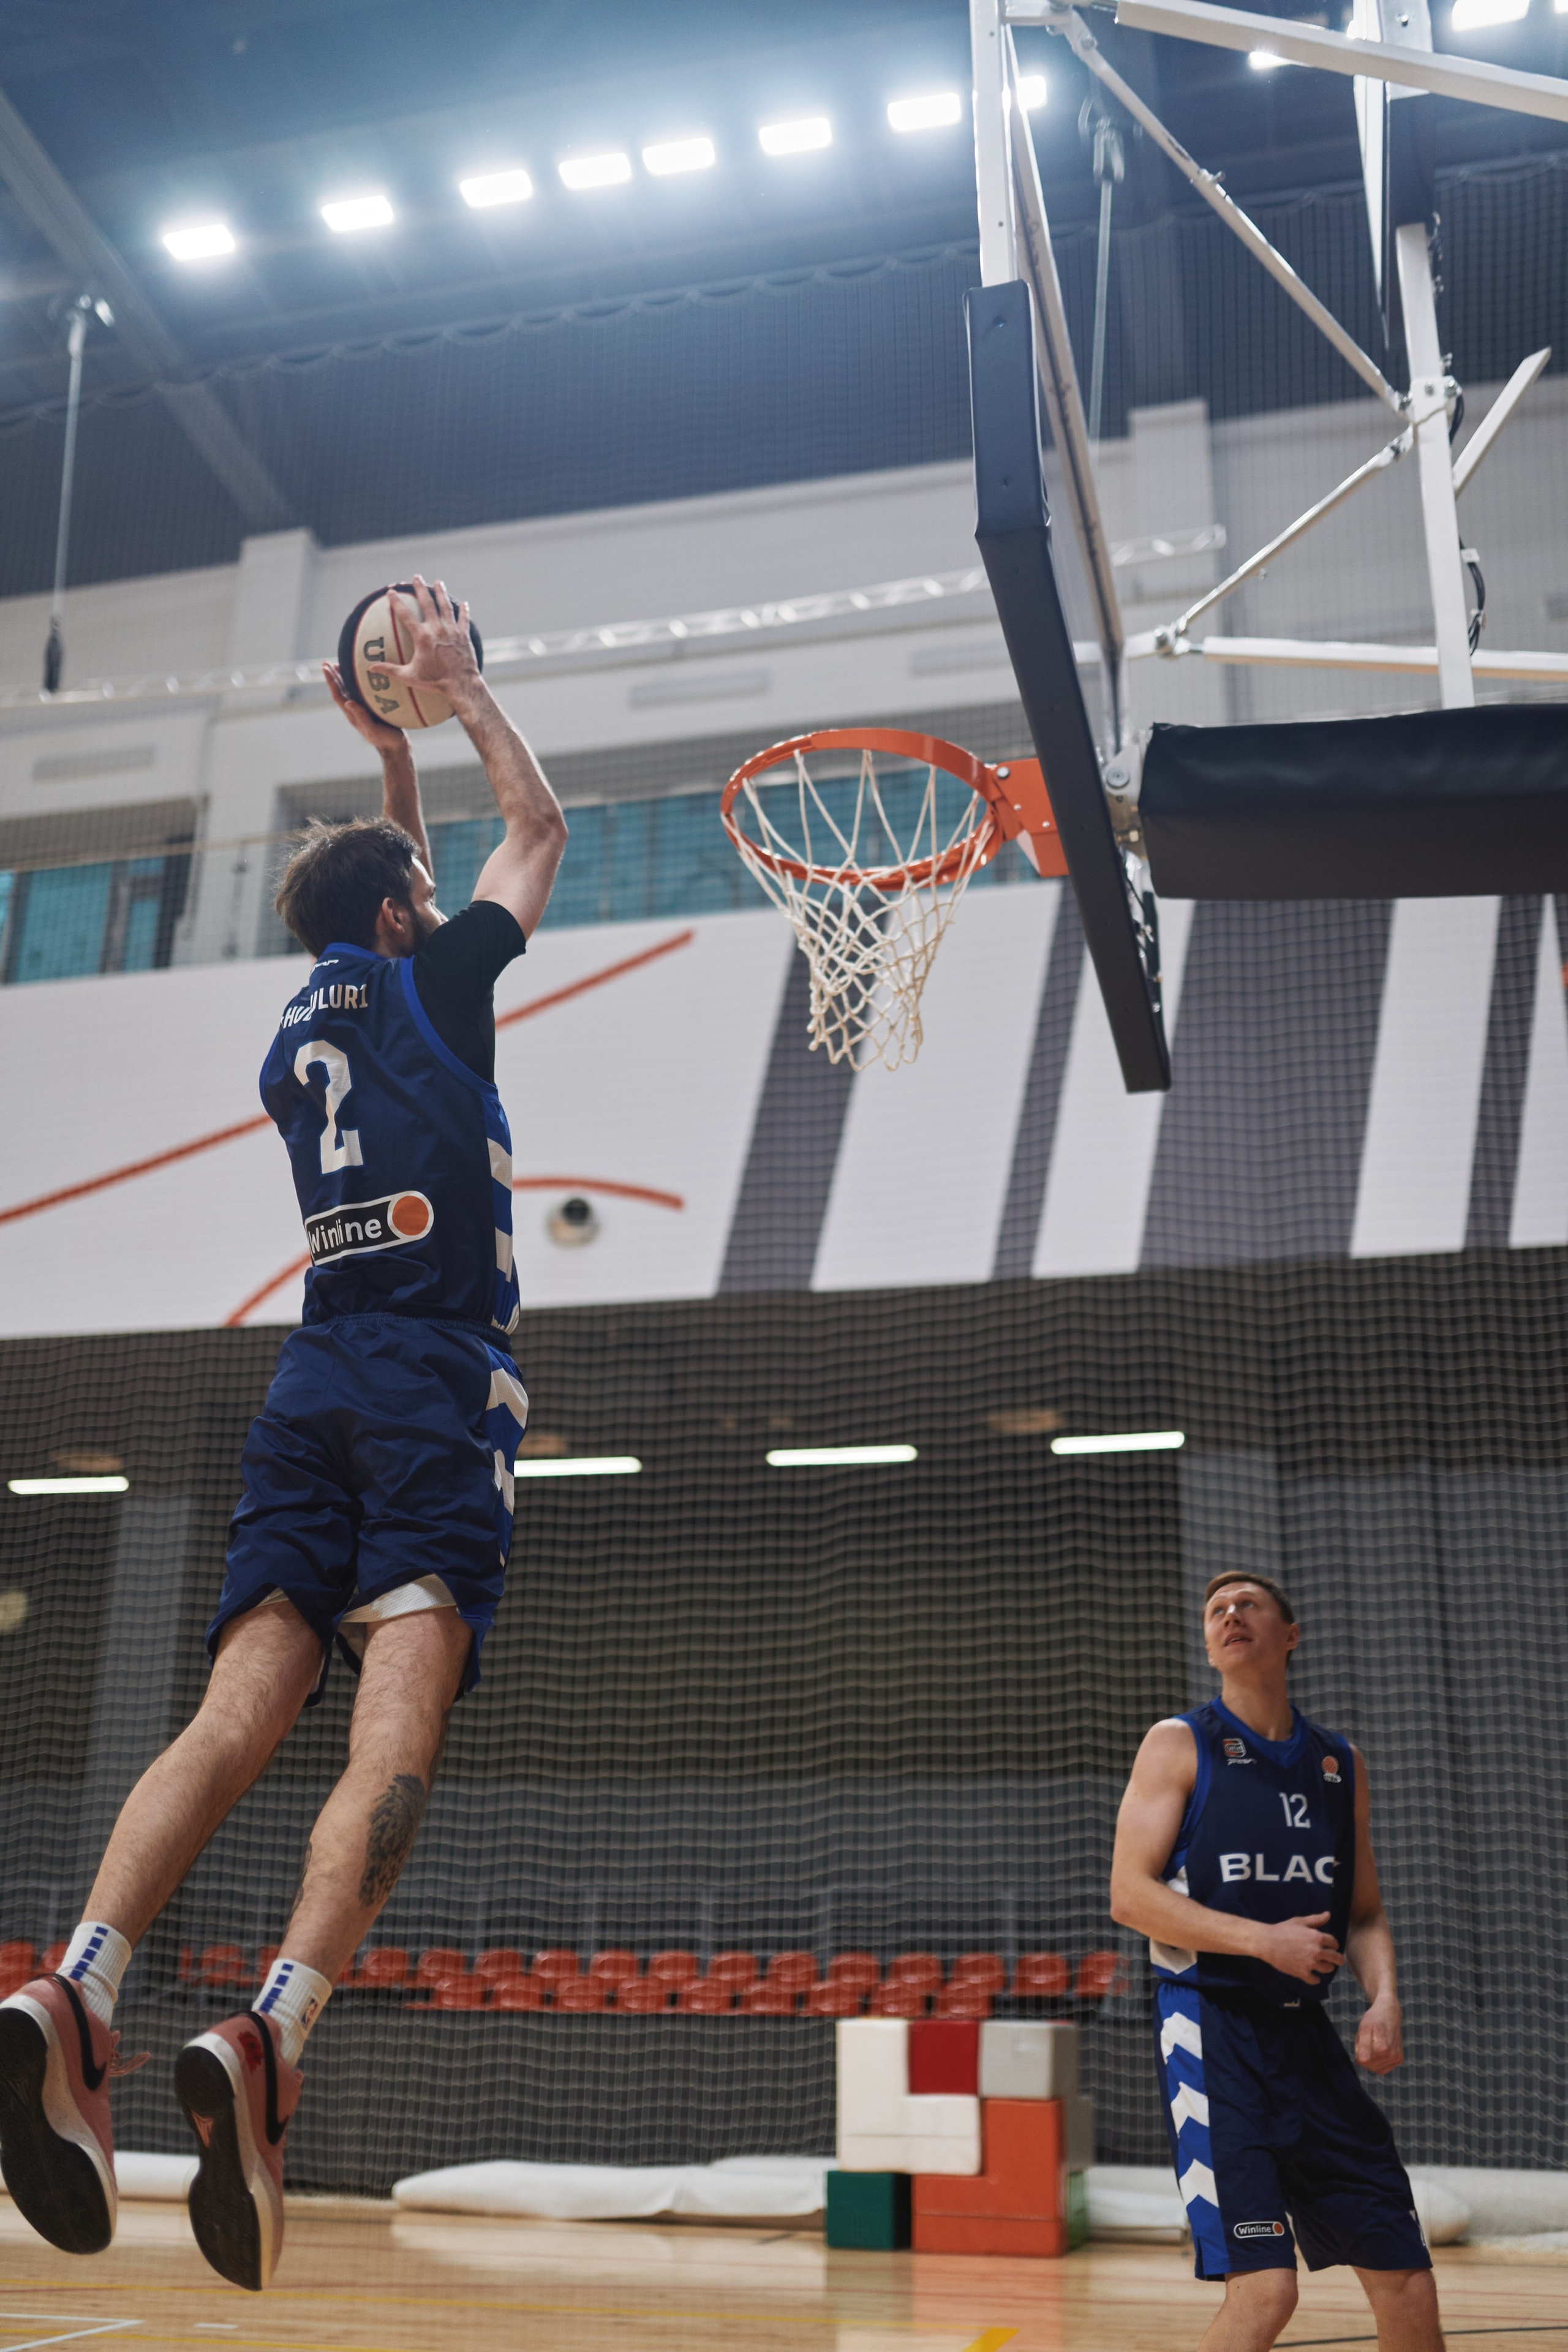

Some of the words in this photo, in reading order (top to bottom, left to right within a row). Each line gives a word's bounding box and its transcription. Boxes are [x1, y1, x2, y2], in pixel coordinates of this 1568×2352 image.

[364, 636, 400, 714] UBA
[293, 1039, 364, 1174] 2
[308, 1218, 382, 1254] Winline
[1279, 1792, 1311, 1828] 12
[1238, 2225, 1272, 2234] Winline
